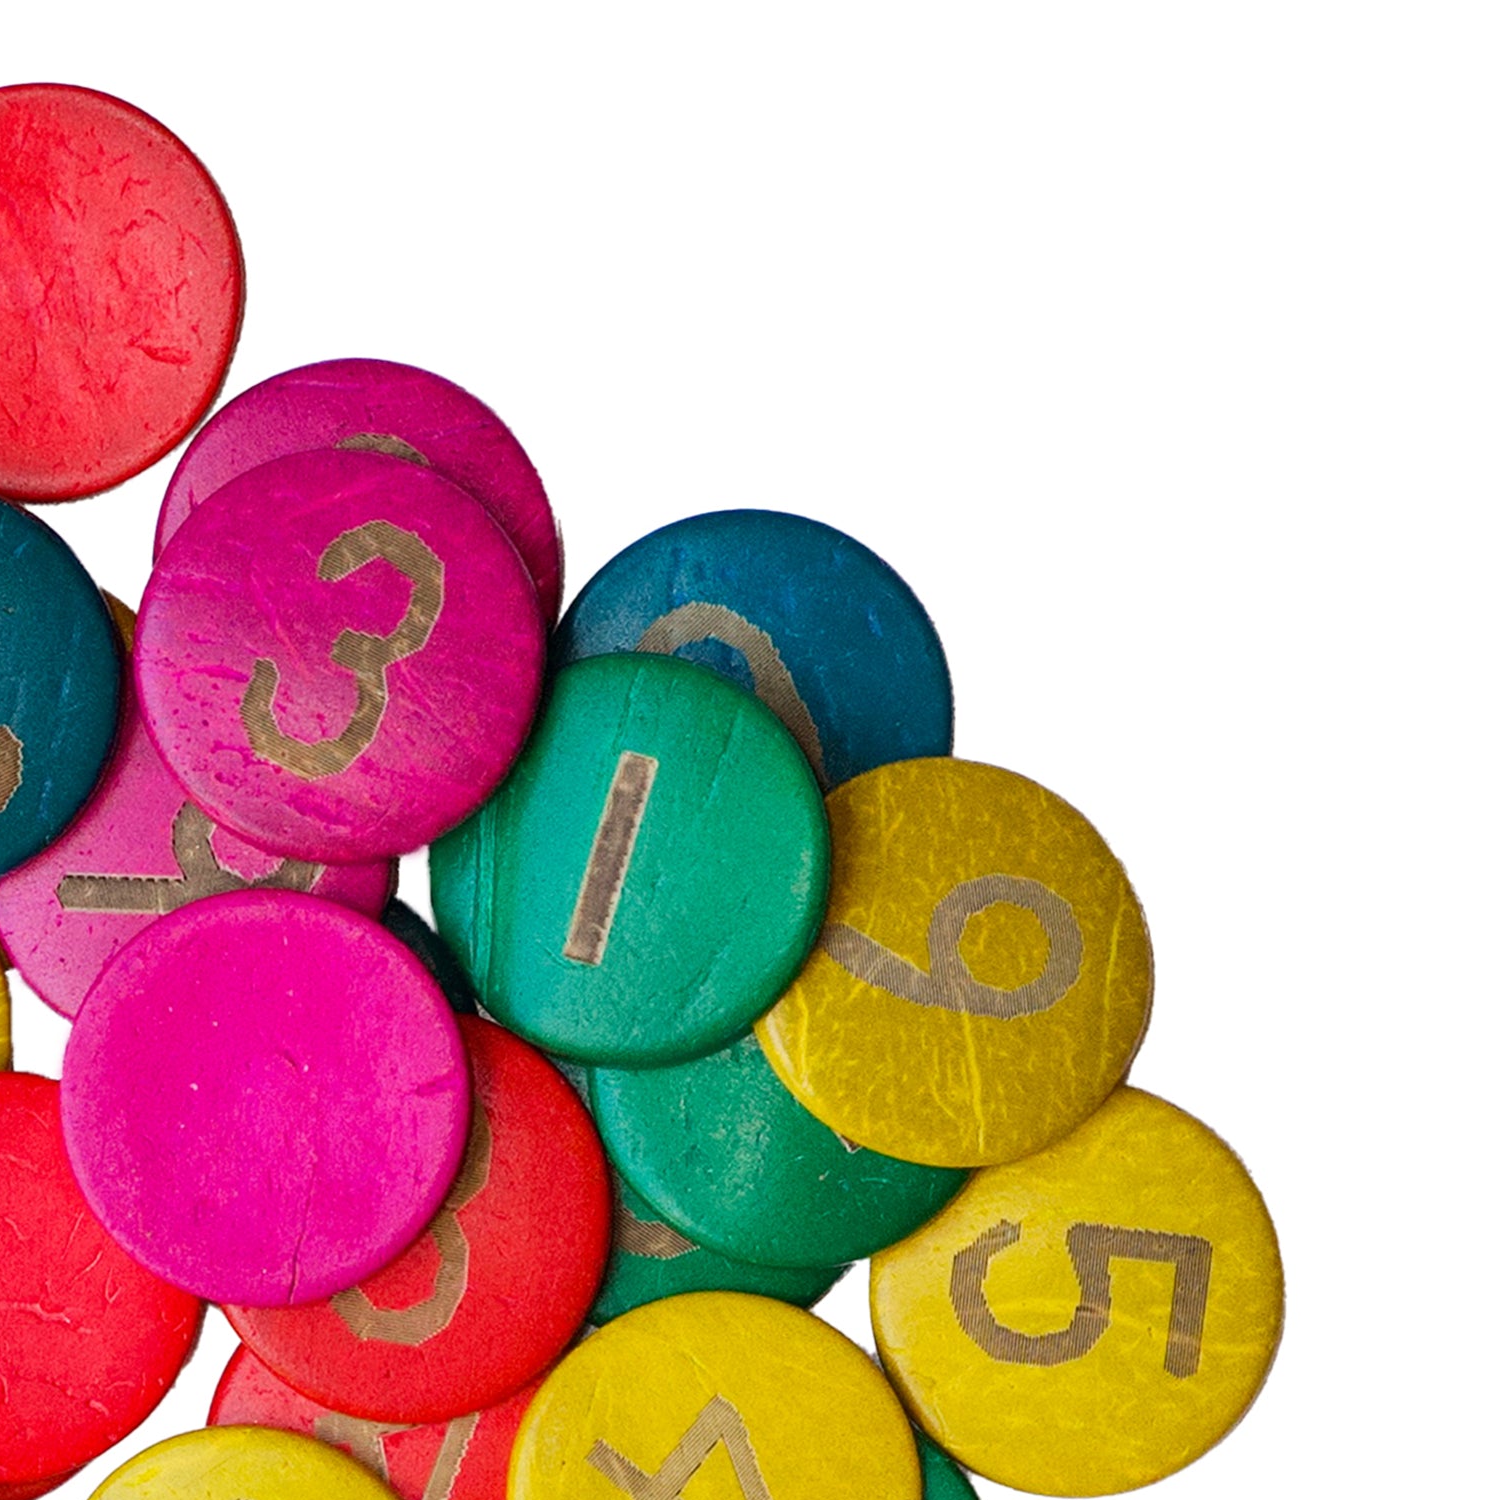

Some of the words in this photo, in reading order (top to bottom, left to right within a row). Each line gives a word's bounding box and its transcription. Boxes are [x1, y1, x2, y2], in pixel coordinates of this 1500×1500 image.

[239, 519, 446, 782] 3
[562, 750, 660, 967] 1
[948, 1218, 1213, 1382] 5
